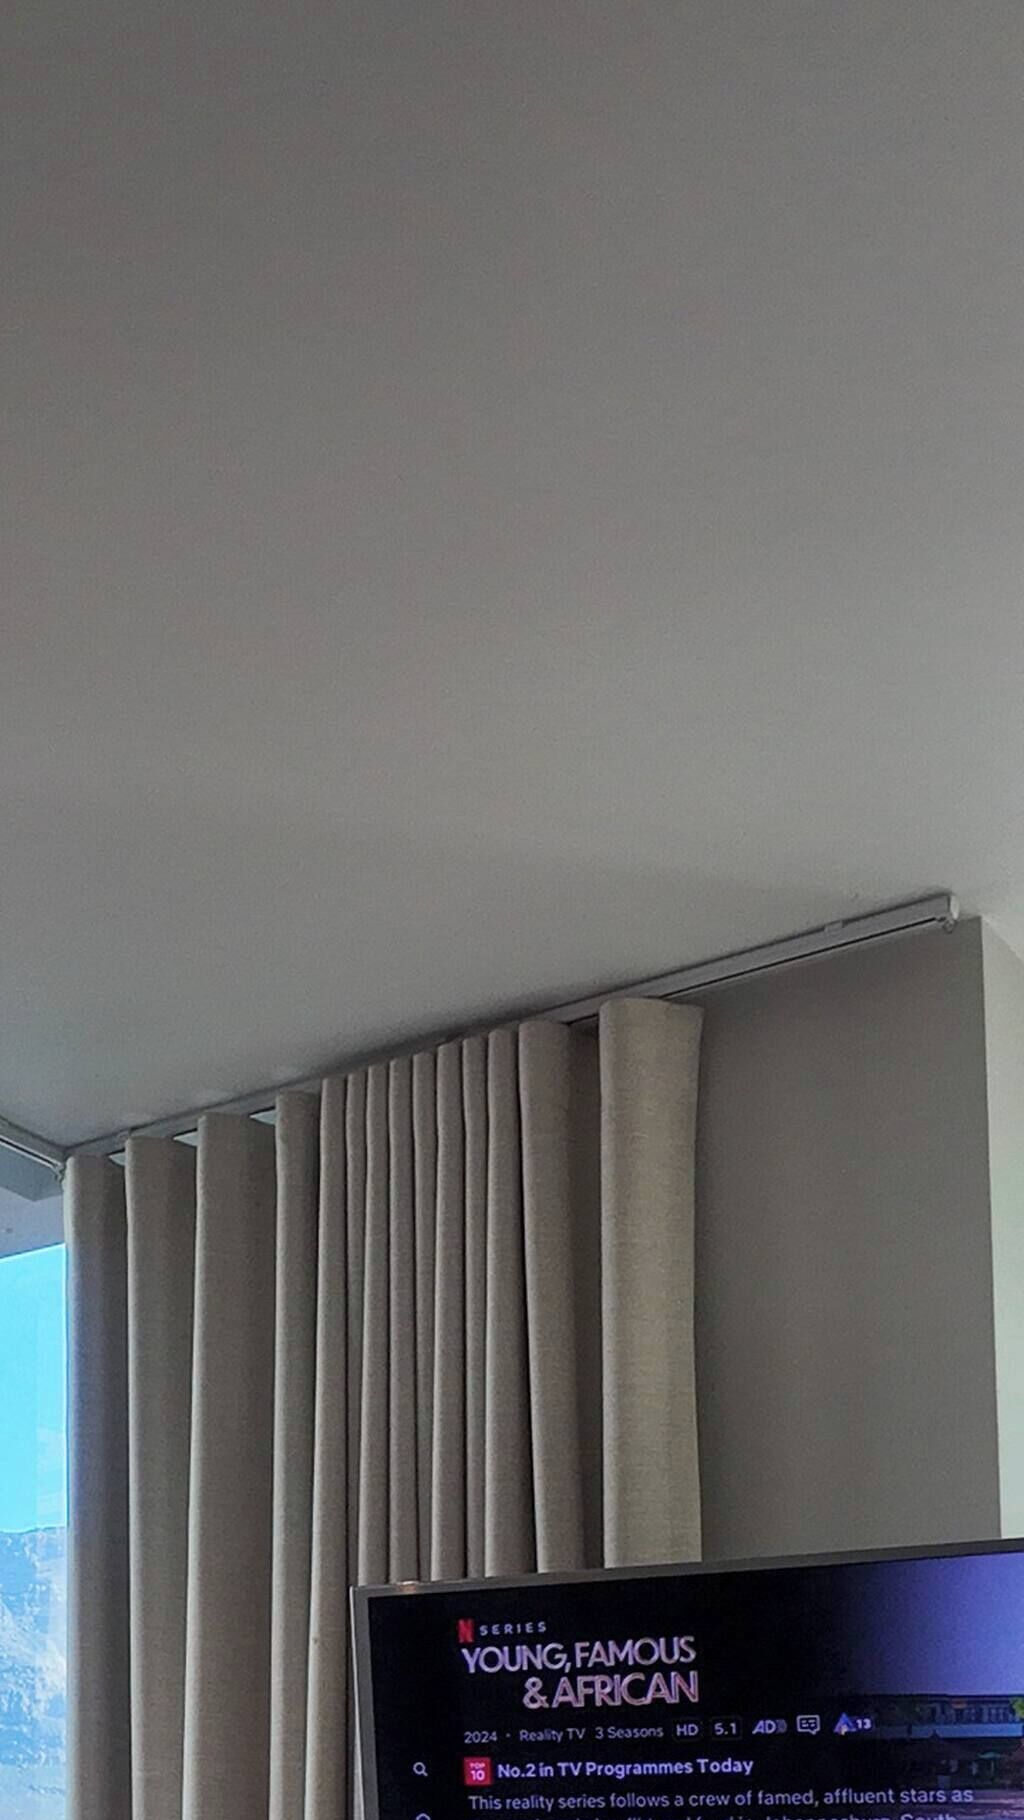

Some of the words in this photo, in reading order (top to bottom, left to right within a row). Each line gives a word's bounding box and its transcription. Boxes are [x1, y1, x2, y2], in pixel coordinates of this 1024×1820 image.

[479, 1621, 547, 1636] SERIES
[461, 1642, 572, 1674] YOUNG,
[574, 1636, 697, 1668] FAMOUS
[522, 1676, 549, 1709] &
[551, 1671, 699, 1708] AFRICAN
[676, 1723, 699, 1737] HD
[714, 1722, 737, 1735] 5.1
[856, 1718, 872, 1730] 13
[464, 1731, 498, 1744] 2024
[519, 1729, 564, 1743] Reality
[566, 1728, 586, 1740] TV
[594, 1726, 605, 1740] 3
[607, 1726, 665, 1739] Seasons
[471, 1771, 485, 1781] 10
[538, 1762, 554, 1777] in
[557, 1762, 582, 1777] TV
[585, 1758, 694, 1779] Programmes
[697, 1757, 755, 1776] Today
[469, 1794, 502, 1810] This
[506, 1794, 553, 1812] reality
[557, 1794, 607, 1809] series
[610, 1792, 670, 1808] follows
[674, 1795, 685, 1807] a
[688, 1794, 730, 1807] crew
[734, 1790, 754, 1806] of
[757, 1788, 820, 1808] famed,
[823, 1787, 896, 1805] affluent
[899, 1787, 947, 1803] stars
[951, 1788, 974, 1803] as
